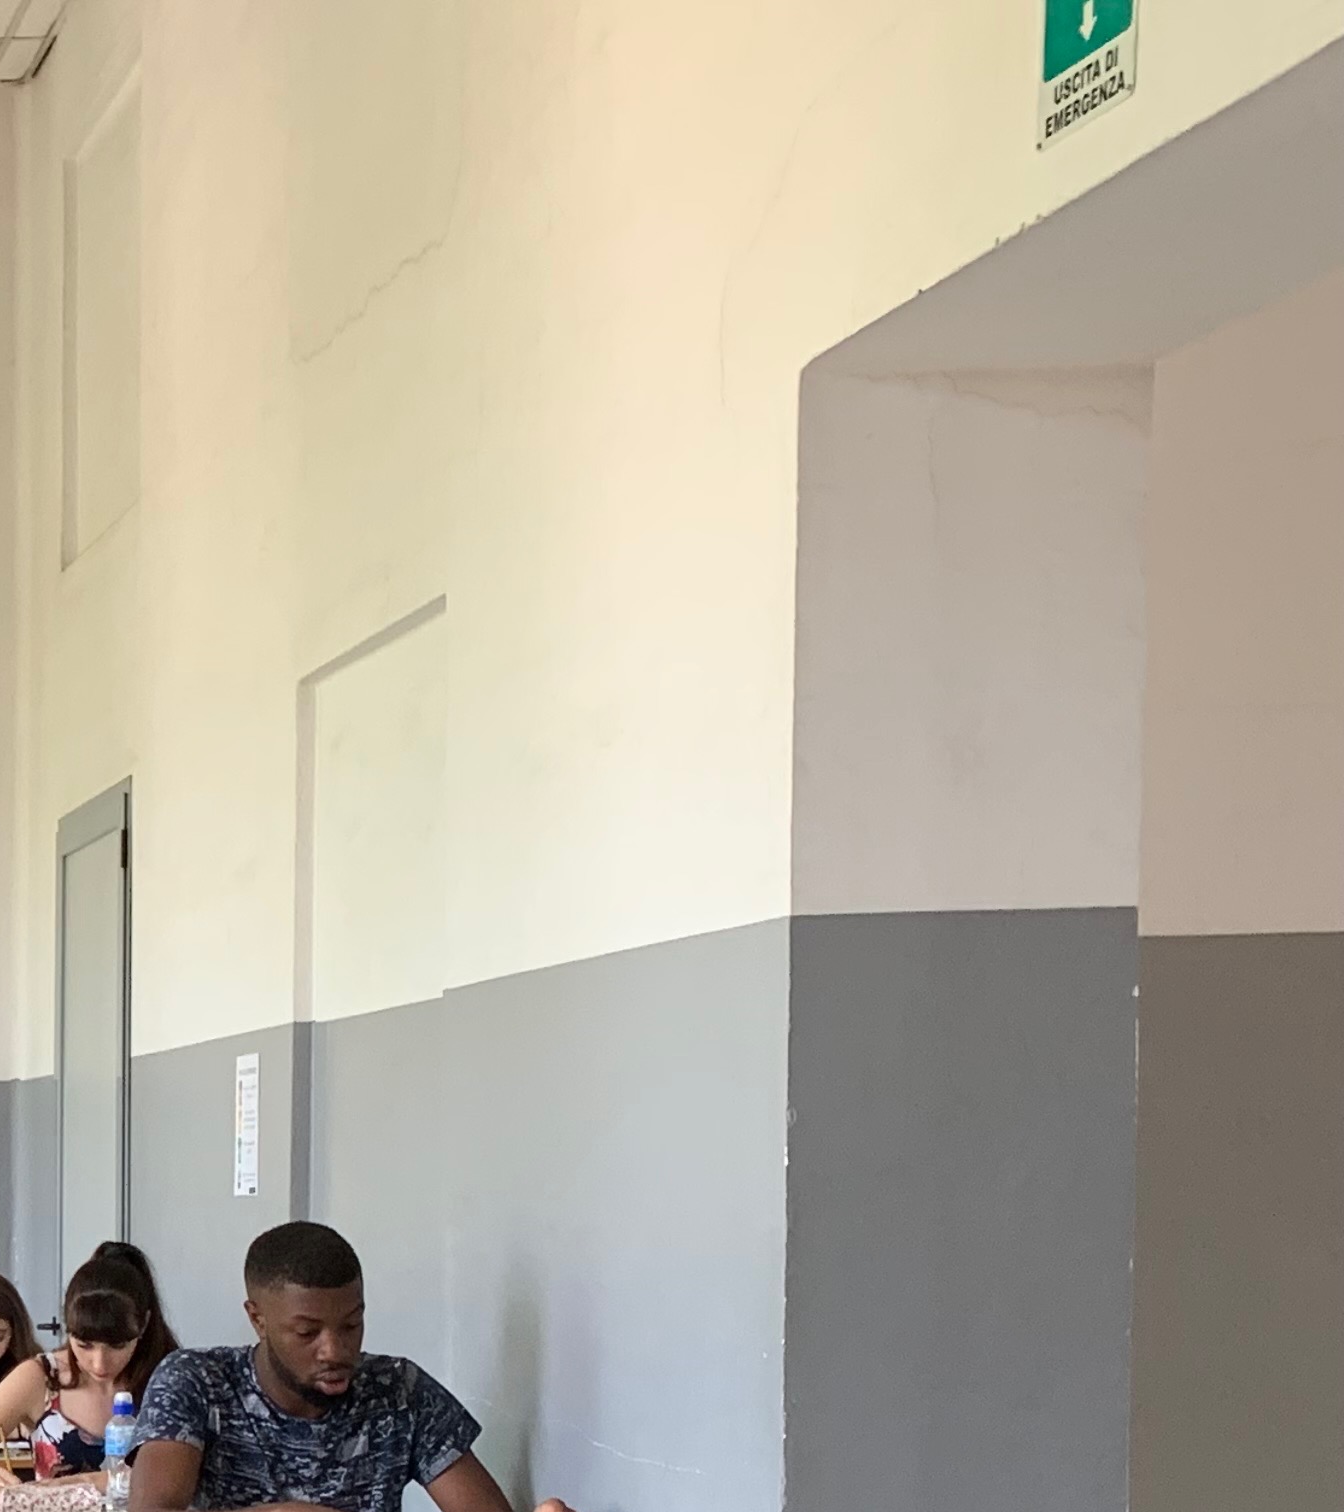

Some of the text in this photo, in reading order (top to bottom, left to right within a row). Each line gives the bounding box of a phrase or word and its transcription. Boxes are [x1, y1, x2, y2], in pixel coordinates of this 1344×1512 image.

[1045, 70, 1125, 139] EMERGENZA
[1054, 45, 1119, 105] USCITA DI
